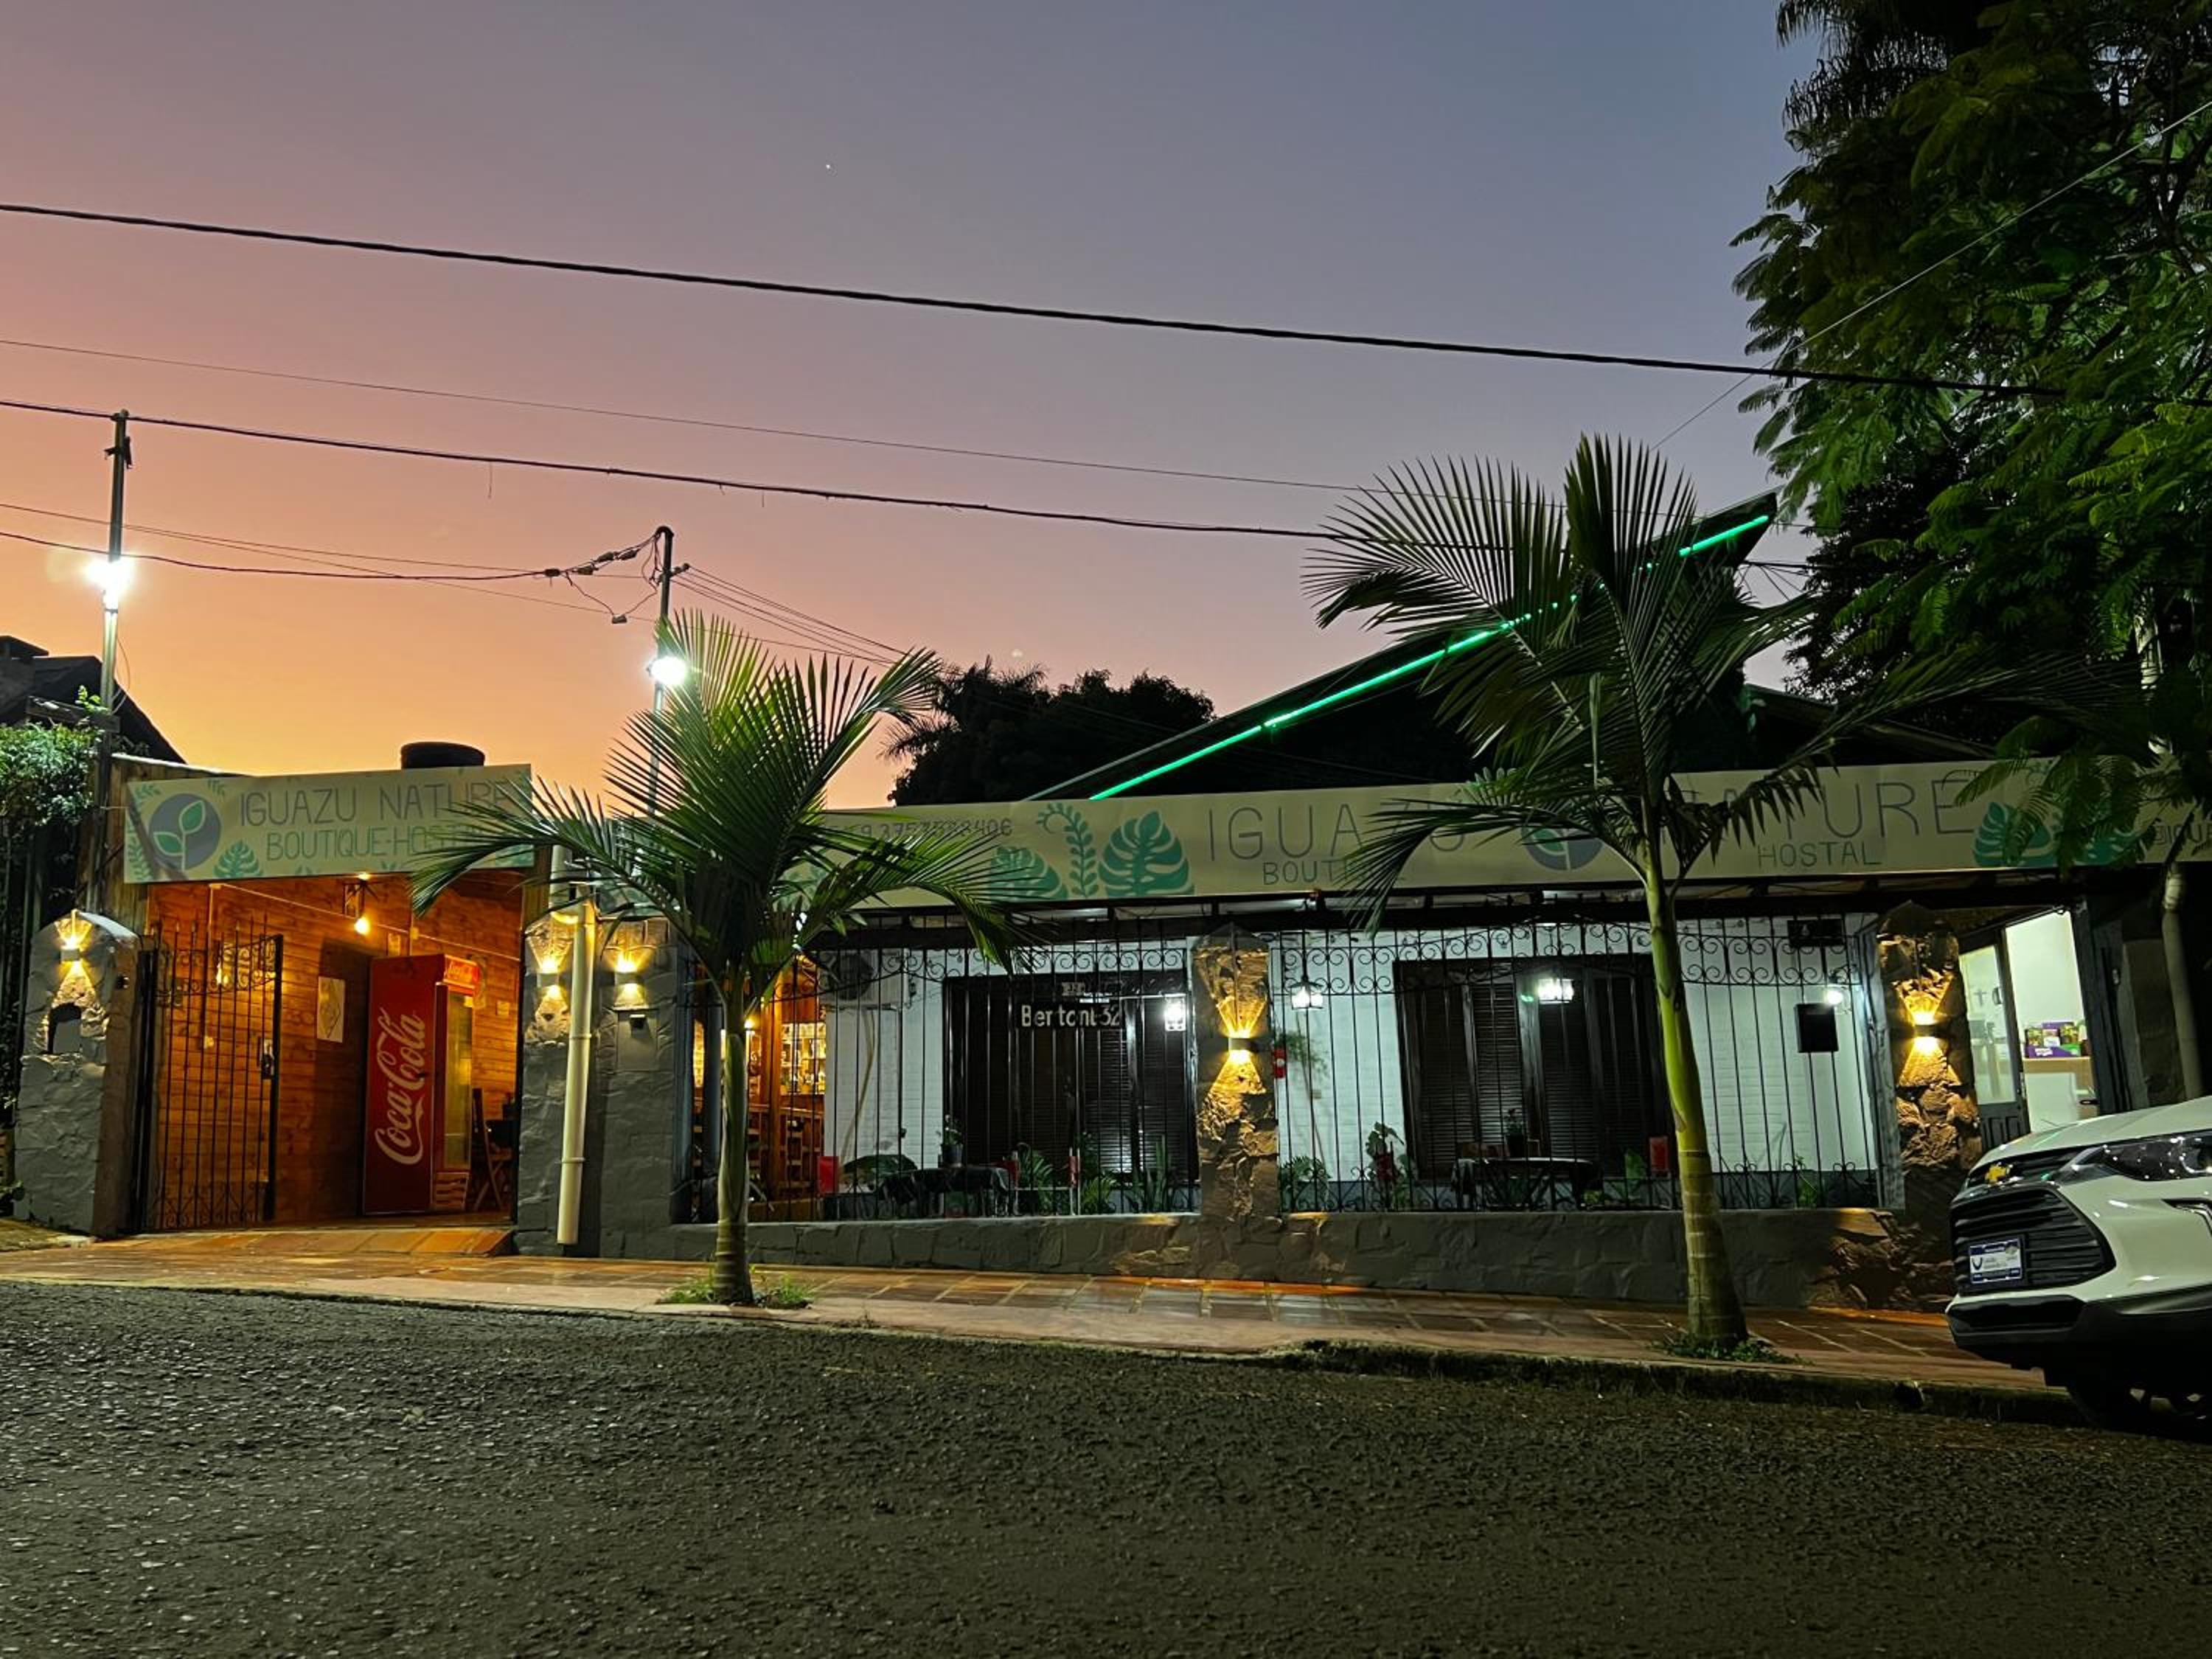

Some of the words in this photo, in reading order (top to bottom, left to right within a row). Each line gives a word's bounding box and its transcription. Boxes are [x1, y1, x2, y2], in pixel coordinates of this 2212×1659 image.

[241, 787, 356, 827] IGUAZU
[1758, 841, 1882, 869] HOSTAL
[375, 1006, 426, 1165] Coca-Cola
